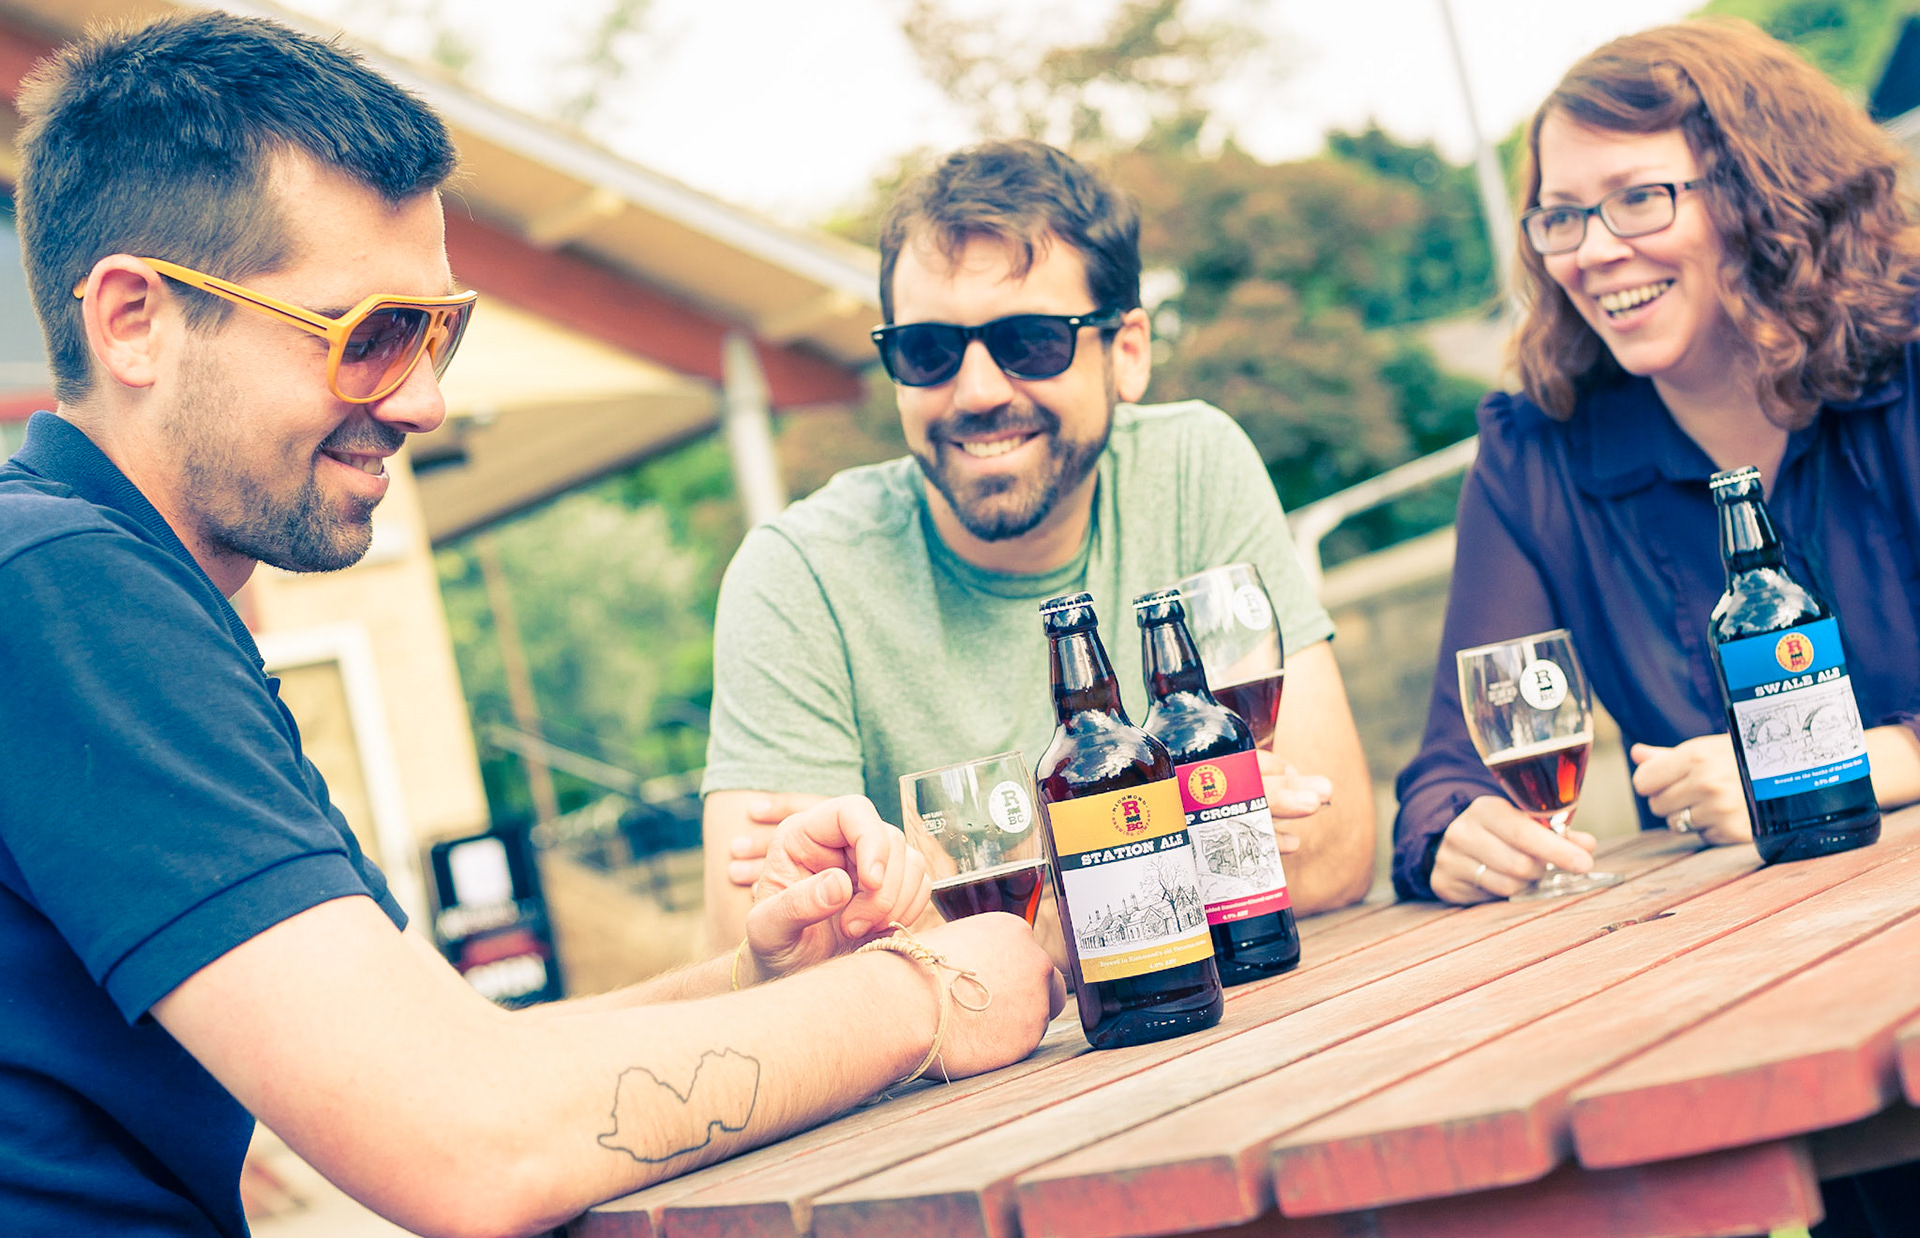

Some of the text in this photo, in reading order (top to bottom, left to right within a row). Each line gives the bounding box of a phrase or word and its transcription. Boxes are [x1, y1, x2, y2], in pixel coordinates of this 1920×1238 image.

[1787, 640, 1802, 653] R
[1754, 666, 1841, 697] SWALE ALE
[1199, 771, 1215, 786] R
[1001, 790, 1020, 806] R
[1121, 800, 1141, 816] R
[1200, 802, 1248, 821] CROSS
[1008, 814, 1025, 825] BC
[1125, 821, 1144, 832] BC
[1081, 833, 1184, 866] STATION ALE
